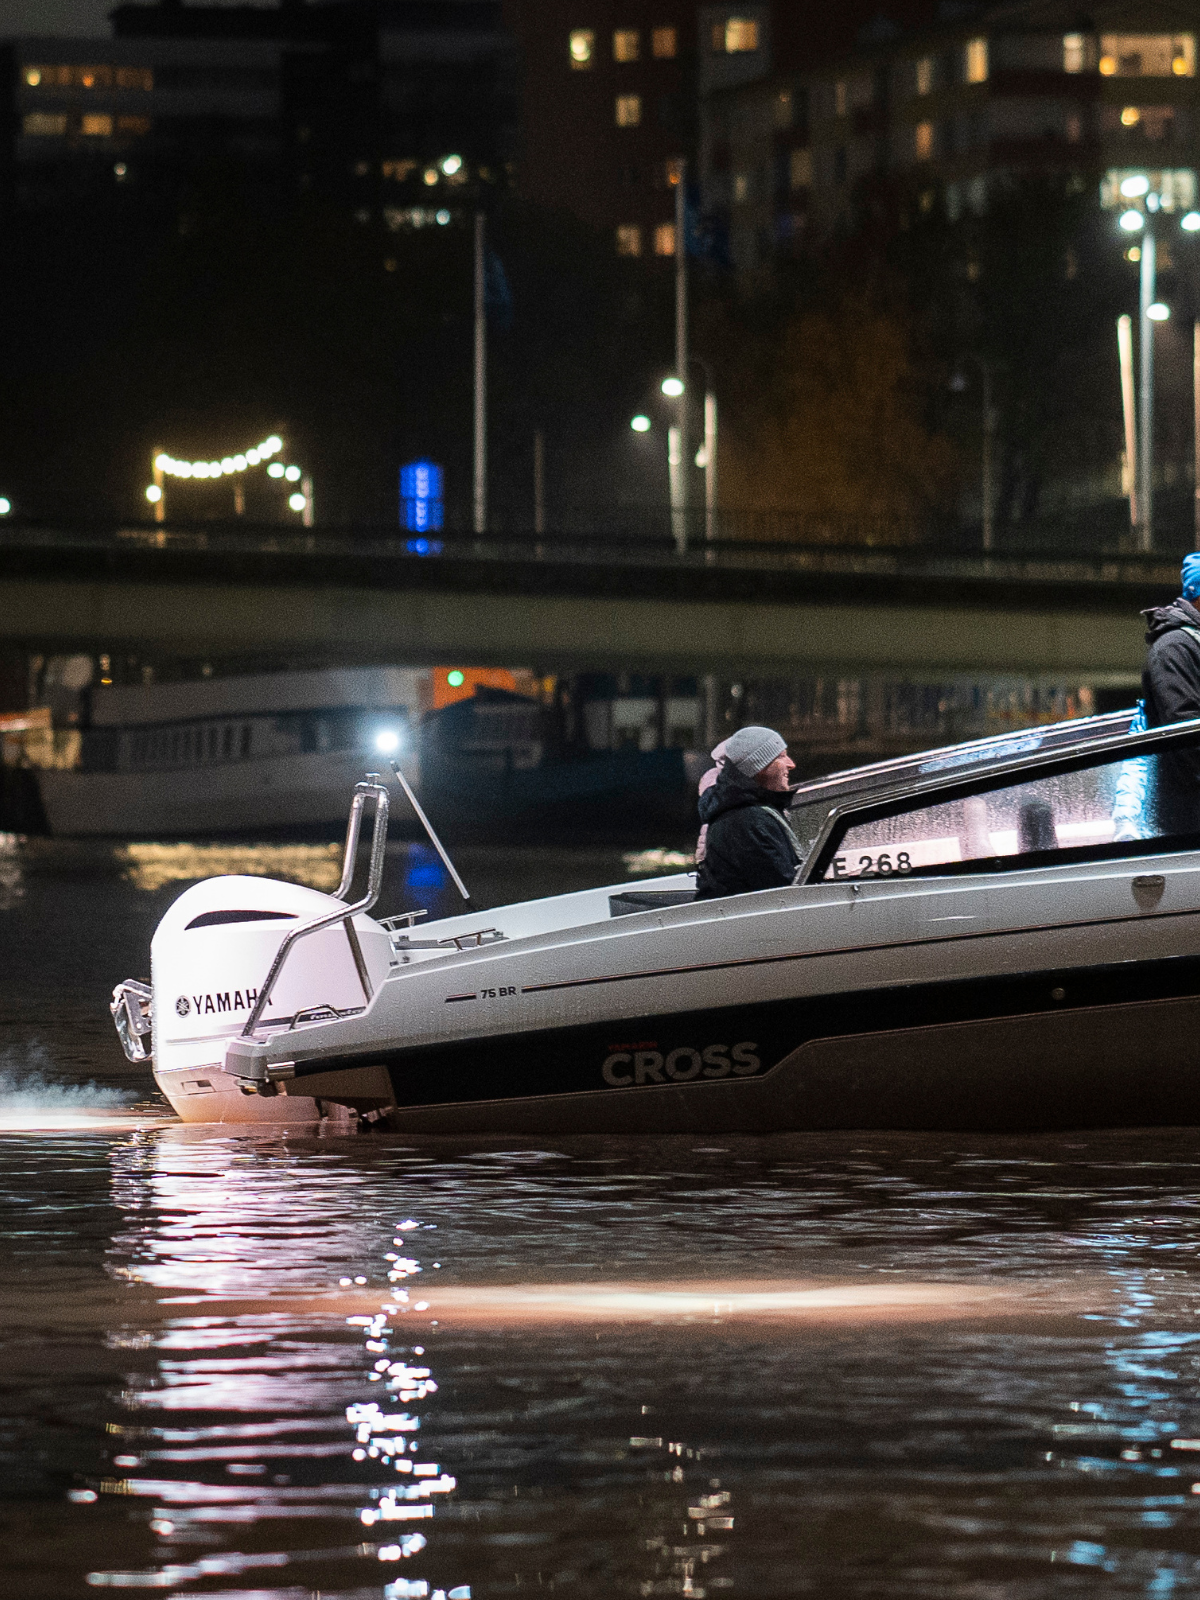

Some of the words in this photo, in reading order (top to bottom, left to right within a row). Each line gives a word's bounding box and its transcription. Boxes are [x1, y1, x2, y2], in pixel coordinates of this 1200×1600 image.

[859, 851, 912, 877] 268
[480, 988, 497, 999] 75
[499, 986, 517, 997] BR
[601, 1041, 762, 1087] CROSS
